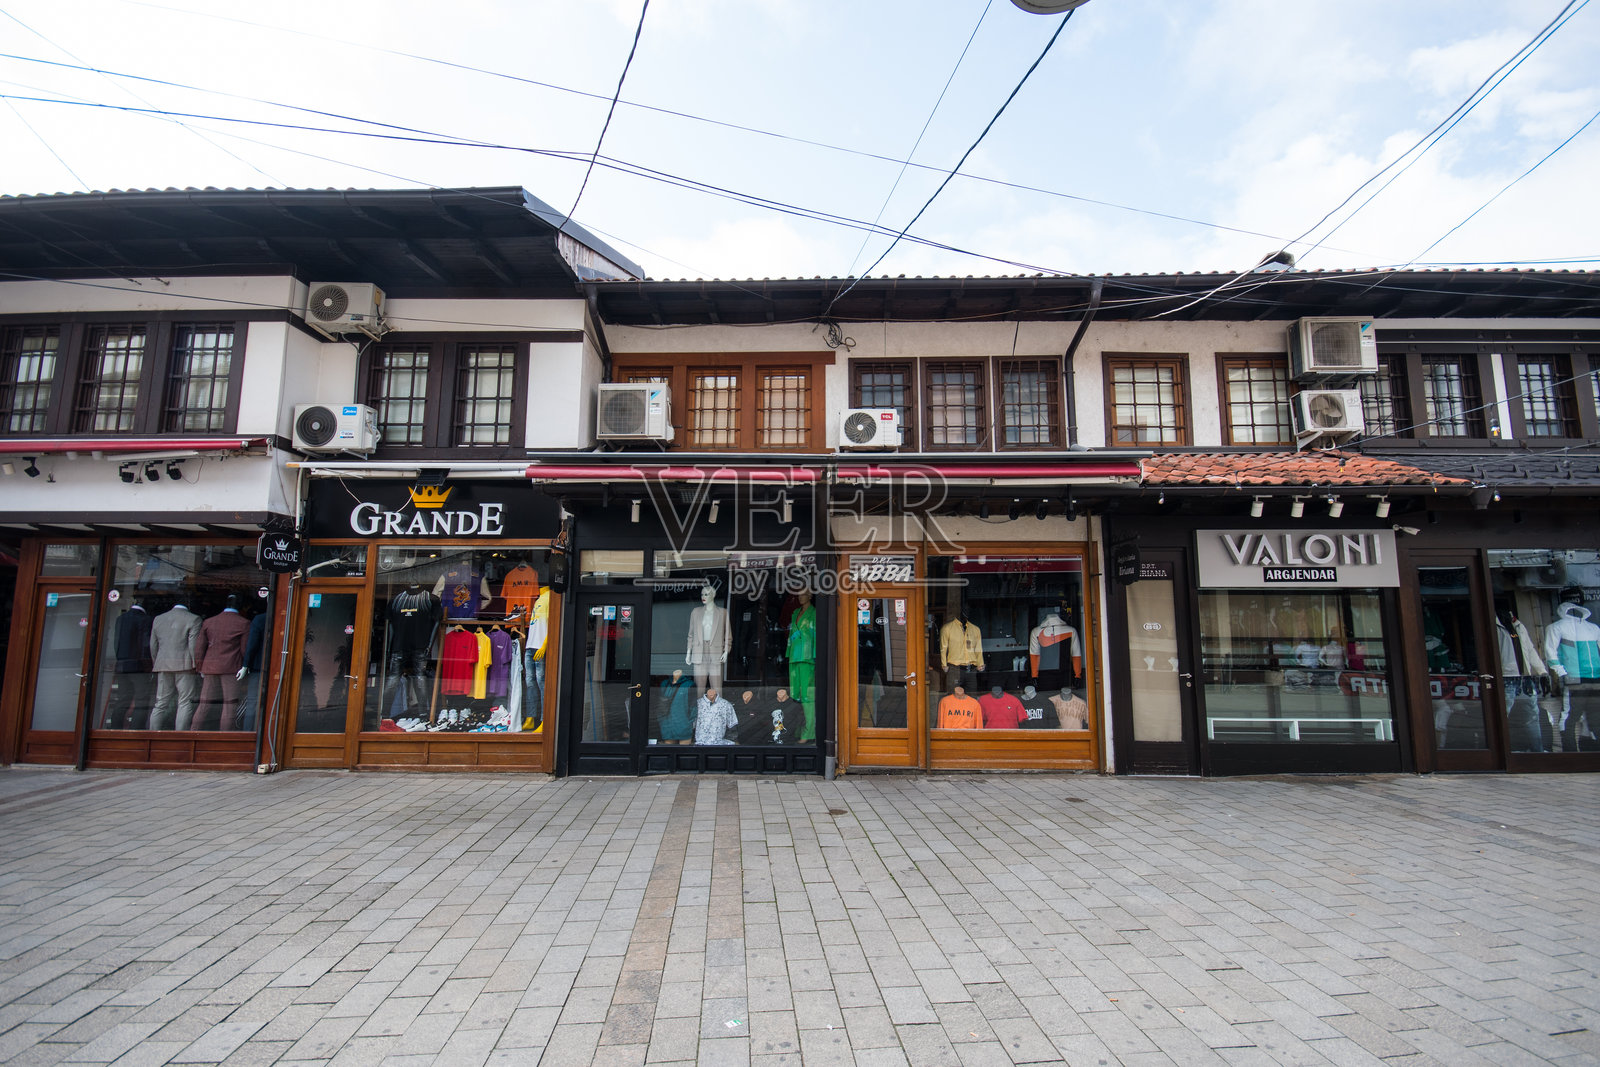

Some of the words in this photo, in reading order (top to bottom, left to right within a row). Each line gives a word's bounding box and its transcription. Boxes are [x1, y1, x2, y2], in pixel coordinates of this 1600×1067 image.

[350, 502, 504, 535] GRANDE
[263, 547, 299, 562] GRANDE
[1222, 533, 1382, 565] VALONI
[1266, 569, 1335, 580] ARGJENDAR
[947, 709, 974, 718] AMIRI
